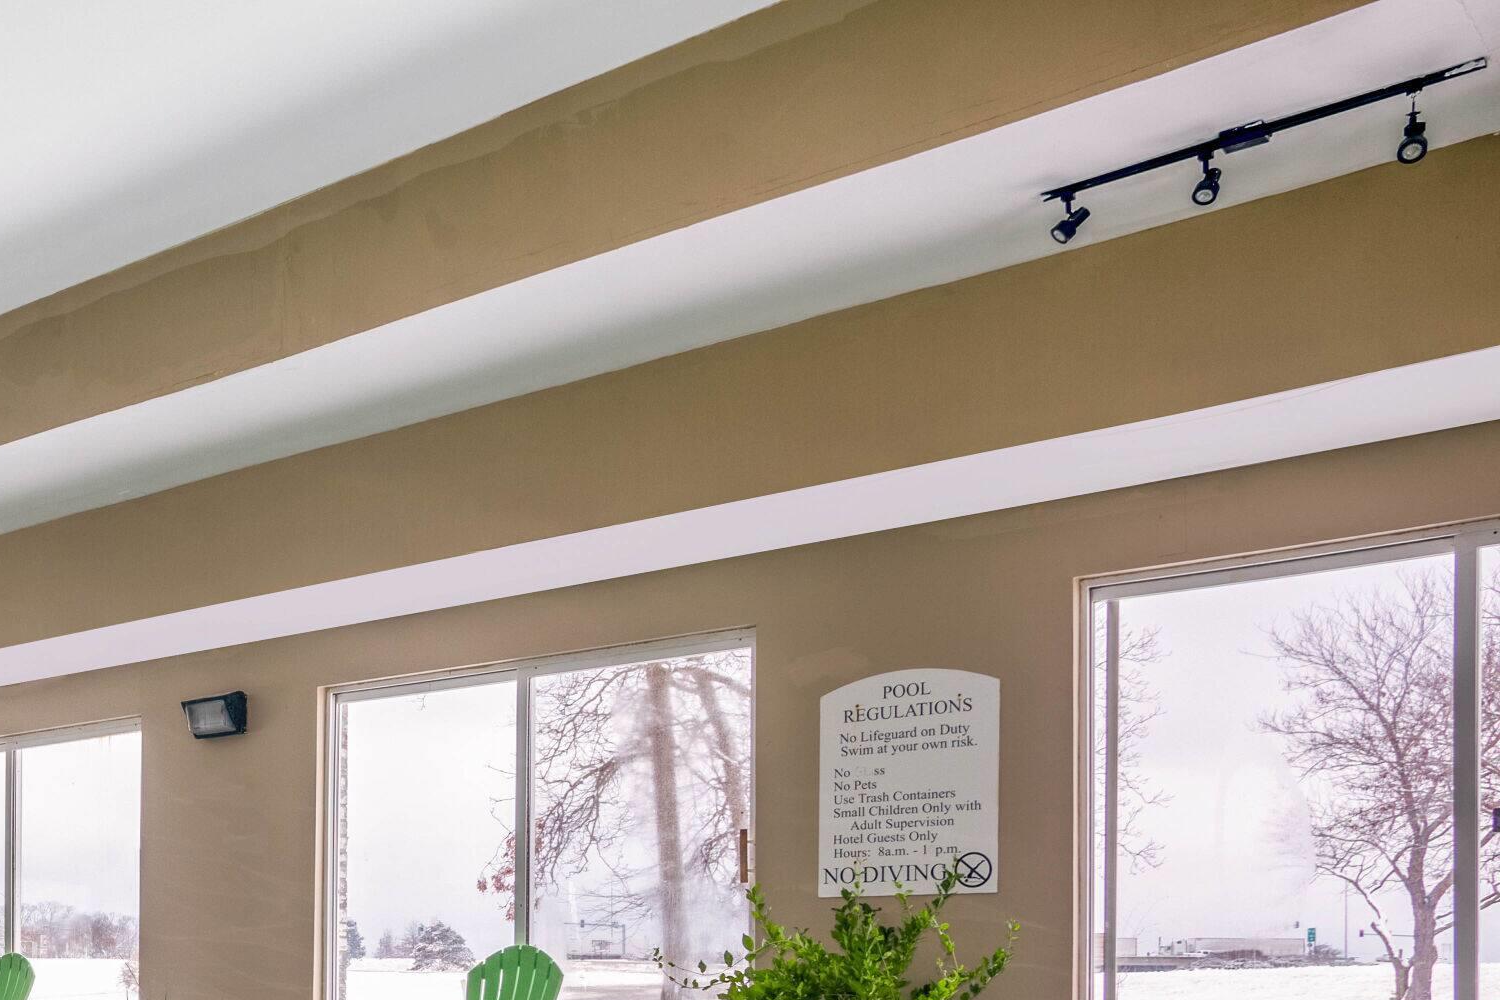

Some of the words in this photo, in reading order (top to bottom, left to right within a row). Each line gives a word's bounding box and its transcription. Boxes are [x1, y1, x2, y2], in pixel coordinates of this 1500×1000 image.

[883, 682, 932, 700] POOL
[844, 698, 972, 724] REGULATIONS
[839, 732, 857, 744] No
[860, 726, 918, 742] Lifeguard
[920, 728, 936, 737] on
[940, 724, 971, 736] Duty
[840, 744, 874, 758] Swim
[877, 743, 888, 754] at
[891, 742, 918, 756] your
[921, 740, 948, 750] own
[950, 735, 978, 748] risk.
[834, 768, 851, 778] No
[834, 782, 851, 792] No
[854, 780, 877, 791] Pets
[834, 794, 855, 805] Use
[858, 792, 889, 804] Trash
[892, 788, 956, 801] Containers
[833, 807, 865, 818] Small
[868, 803, 918, 817] Children
[922, 802, 951, 816] Only
[955, 800, 982, 812] with
[850, 820, 882, 831] Adult
[885, 816, 954, 831] Supervision
[833, 833, 864, 845] Hotel
[866, 832, 906, 844] Guests
[908, 830, 938, 844] Only
[833, 848, 871, 859] Hours:
[878, 846, 910, 858] 8a.m.
[935, 846, 962, 856] p.m.
[823, 867, 856, 885] NO
[862, 863, 948, 883] DIVING
